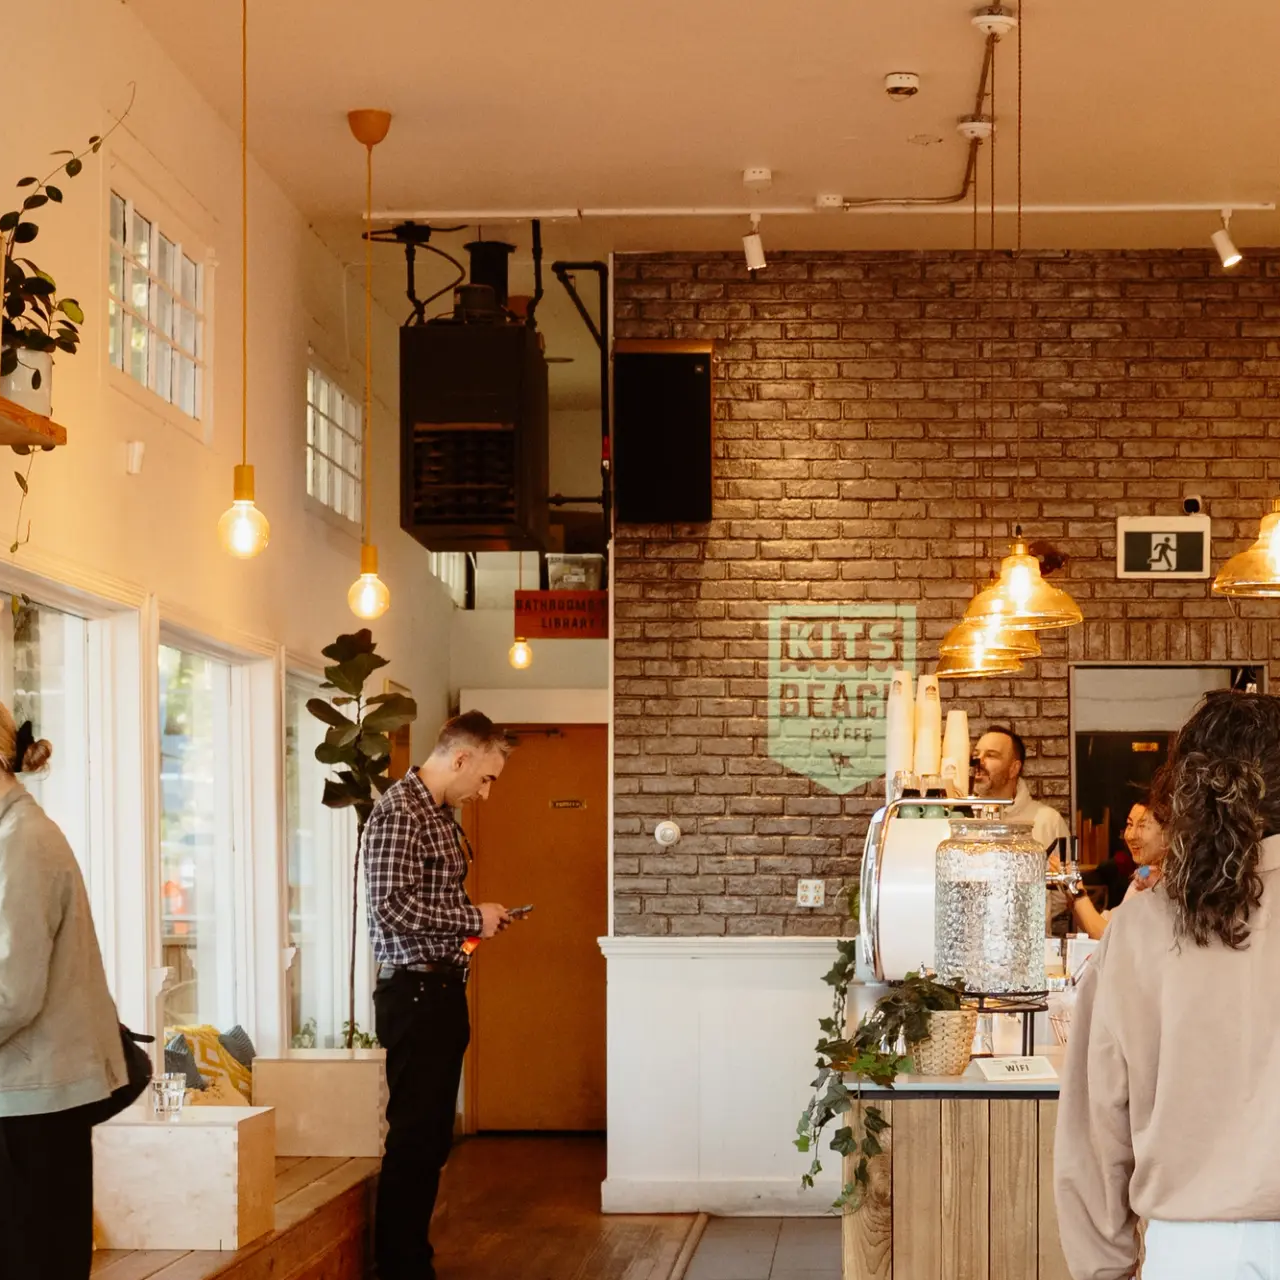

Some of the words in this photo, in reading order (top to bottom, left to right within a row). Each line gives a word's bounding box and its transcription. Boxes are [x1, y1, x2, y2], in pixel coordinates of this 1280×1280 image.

[541, 617, 595, 629] LIBRARY
[788, 623, 896, 659] KITS
[810, 728, 873, 742] COFFEE
